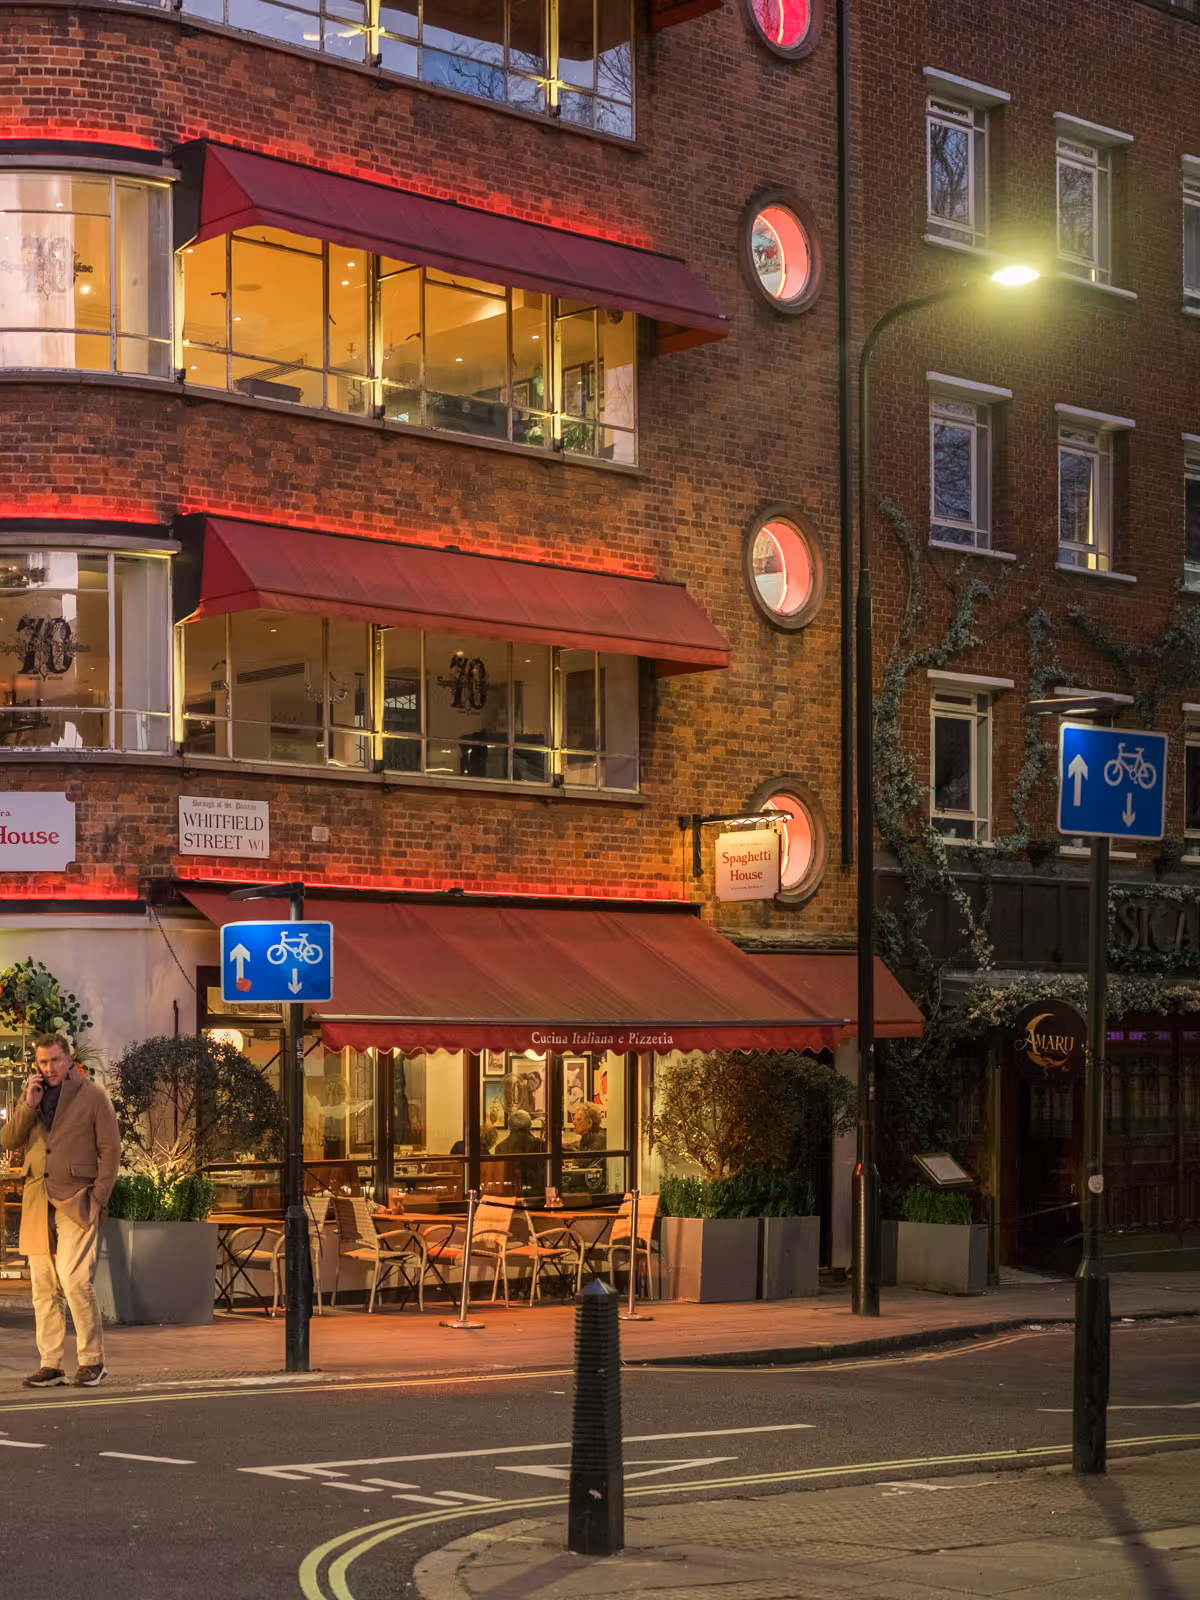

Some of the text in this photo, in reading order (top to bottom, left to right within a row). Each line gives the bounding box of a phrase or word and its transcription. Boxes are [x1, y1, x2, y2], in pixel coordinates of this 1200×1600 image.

[183, 812, 264, 831] WHITFIELD
[184, 832, 243, 850] STREET
[722, 850, 771, 867] Spaghetti
[730, 869, 763, 881] House
[531, 1032, 674, 1044] Cucina Italiana e Pizzeria
[1015, 1028, 1075, 1055] AMARU
